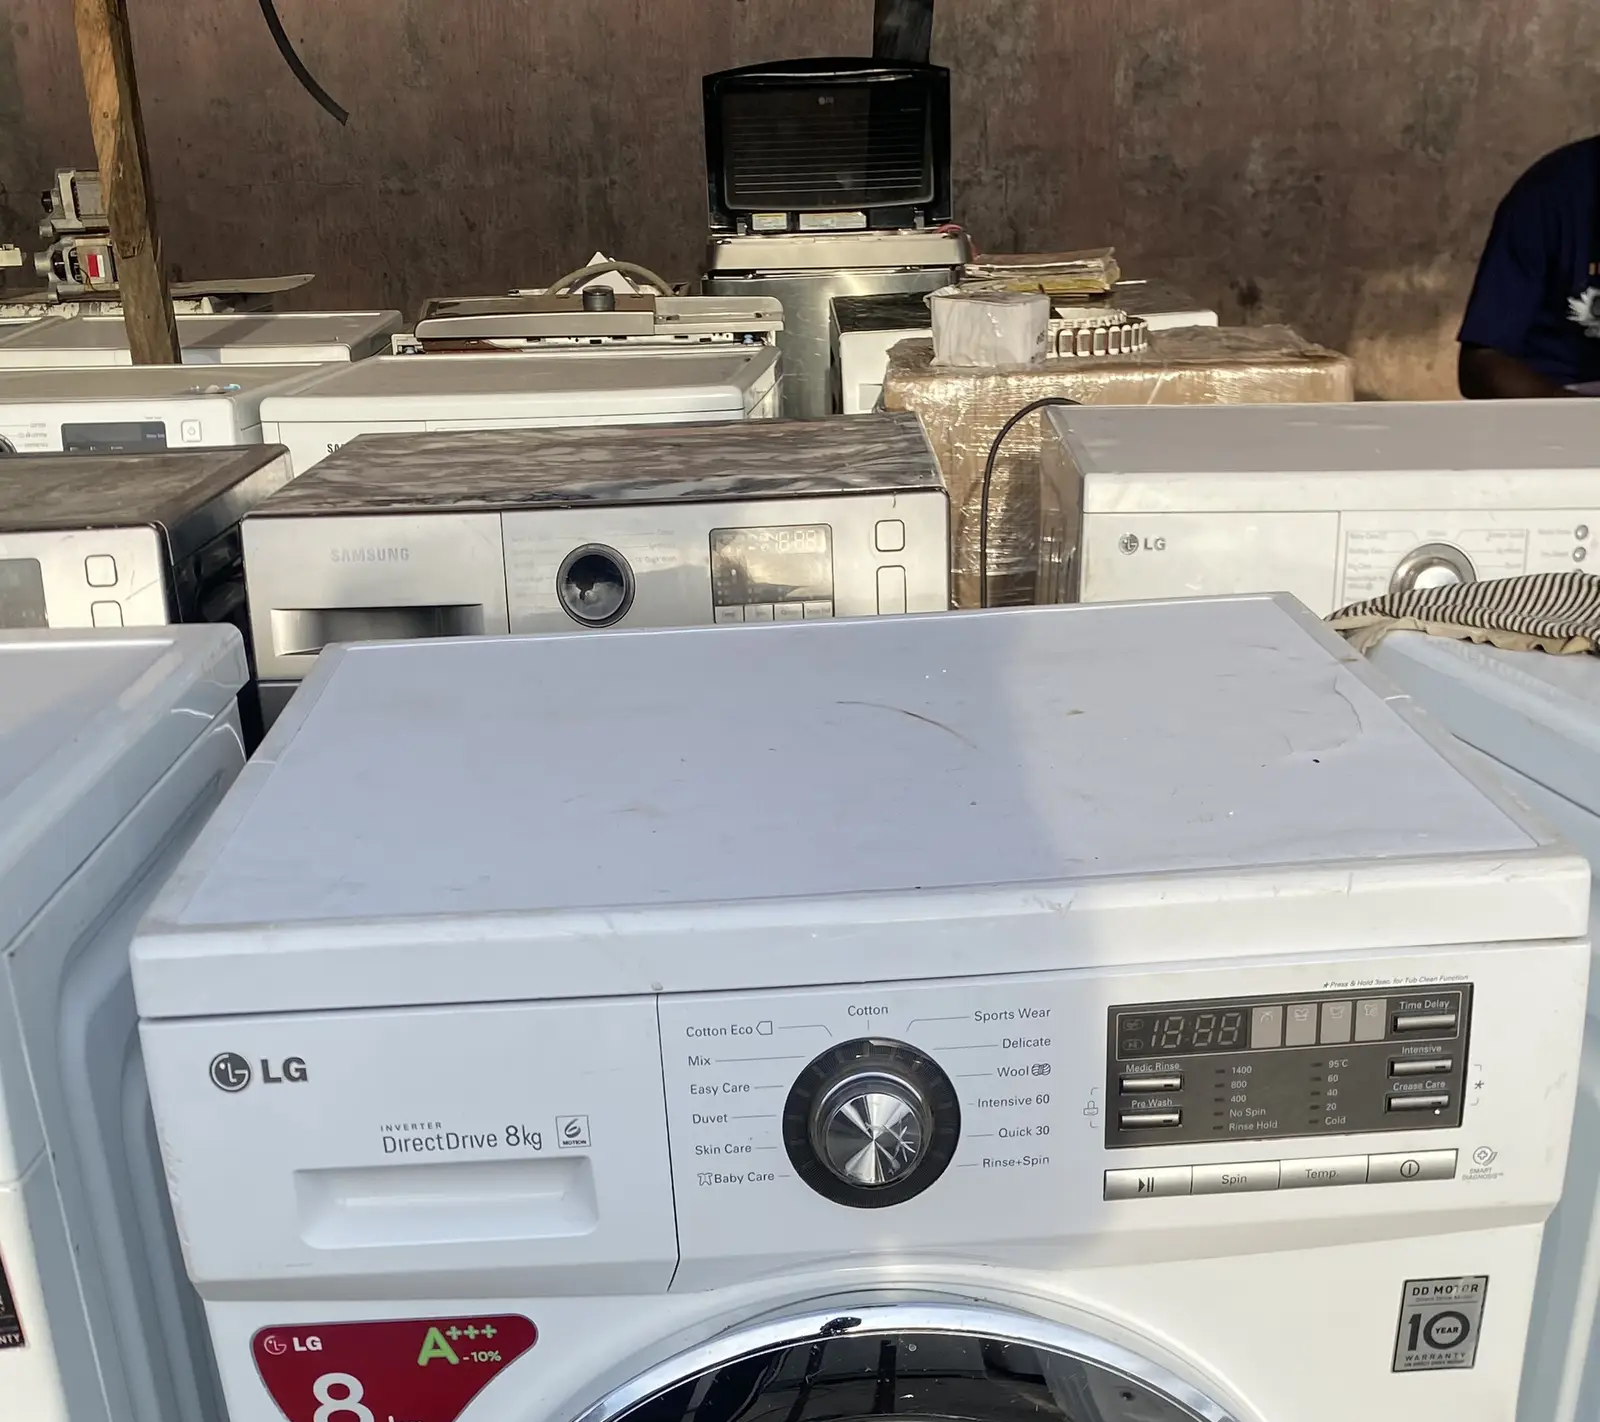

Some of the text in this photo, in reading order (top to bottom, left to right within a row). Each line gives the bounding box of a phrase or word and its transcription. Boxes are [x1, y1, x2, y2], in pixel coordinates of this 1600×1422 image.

[1143, 536, 1166, 551] LG
[330, 547, 410, 563] SAMSUNG
[1330, 981, 1348, 989] Press
[1357, 979, 1373, 987] Hold
[1393, 977, 1402, 985] for
[1405, 976, 1418, 984] Tub
[1419, 975, 1438, 983] Clean
[1439, 974, 1469, 982] Function
[847, 1004, 889, 1017] Cotton
[1400, 999, 1450, 1010] Time Delay
[974, 1007, 1051, 1024] Sports Wear
[686, 1023, 753, 1037] Cotton Eco
[1002, 1036, 1051, 1049] Delicate
[1402, 1045, 1442, 1055] Intensive
[687, 1054, 711, 1067] Mix
[1126, 1061, 1180, 1073] Medic Rinse
[261, 1056, 308, 1084] LG
[997, 1065, 1030, 1078] Wool
[1231, 1065, 1252, 1074] 1400
[1230, 1080, 1247, 1089] 800
[1327, 1074, 1339, 1083] 60
[690, 1081, 750, 1097] Easy Care
[1393, 1080, 1446, 1091] Crease Care
[1230, 1094, 1247, 1103] 400
[1326, 1088, 1338, 1097] 40
[977, 1094, 1050, 1108] Intensive 60
[1131, 1098, 1173, 1108] Pre Wash
[1326, 1103, 1337, 1111] 20
[692, 1112, 728, 1125] Duvet
[1229, 1107, 1266, 1118] No Spin
[380, 1121, 443, 1133] INVERTER
[1228, 1120, 1278, 1131] Rinse Hold
[1325, 1116, 1346, 1126] Cold
[998, 1125, 1050, 1139] Quick 30
[695, 1142, 752, 1155] Skin Care
[982, 1155, 1050, 1169] Rinse+Spin
[714, 1170, 775, 1185] Baby Care
[1221, 1173, 1247, 1185] Spin
[1305, 1167, 1339, 1180] Temp.
[1412, 1286, 1429, 1296] DD
[1407, 1311, 1470, 1351] 10
[1435, 1326, 1459, 1334] YEAR
[293, 1336, 323, 1352] LG
[1405, 1352, 1466, 1361] WARRANTY
